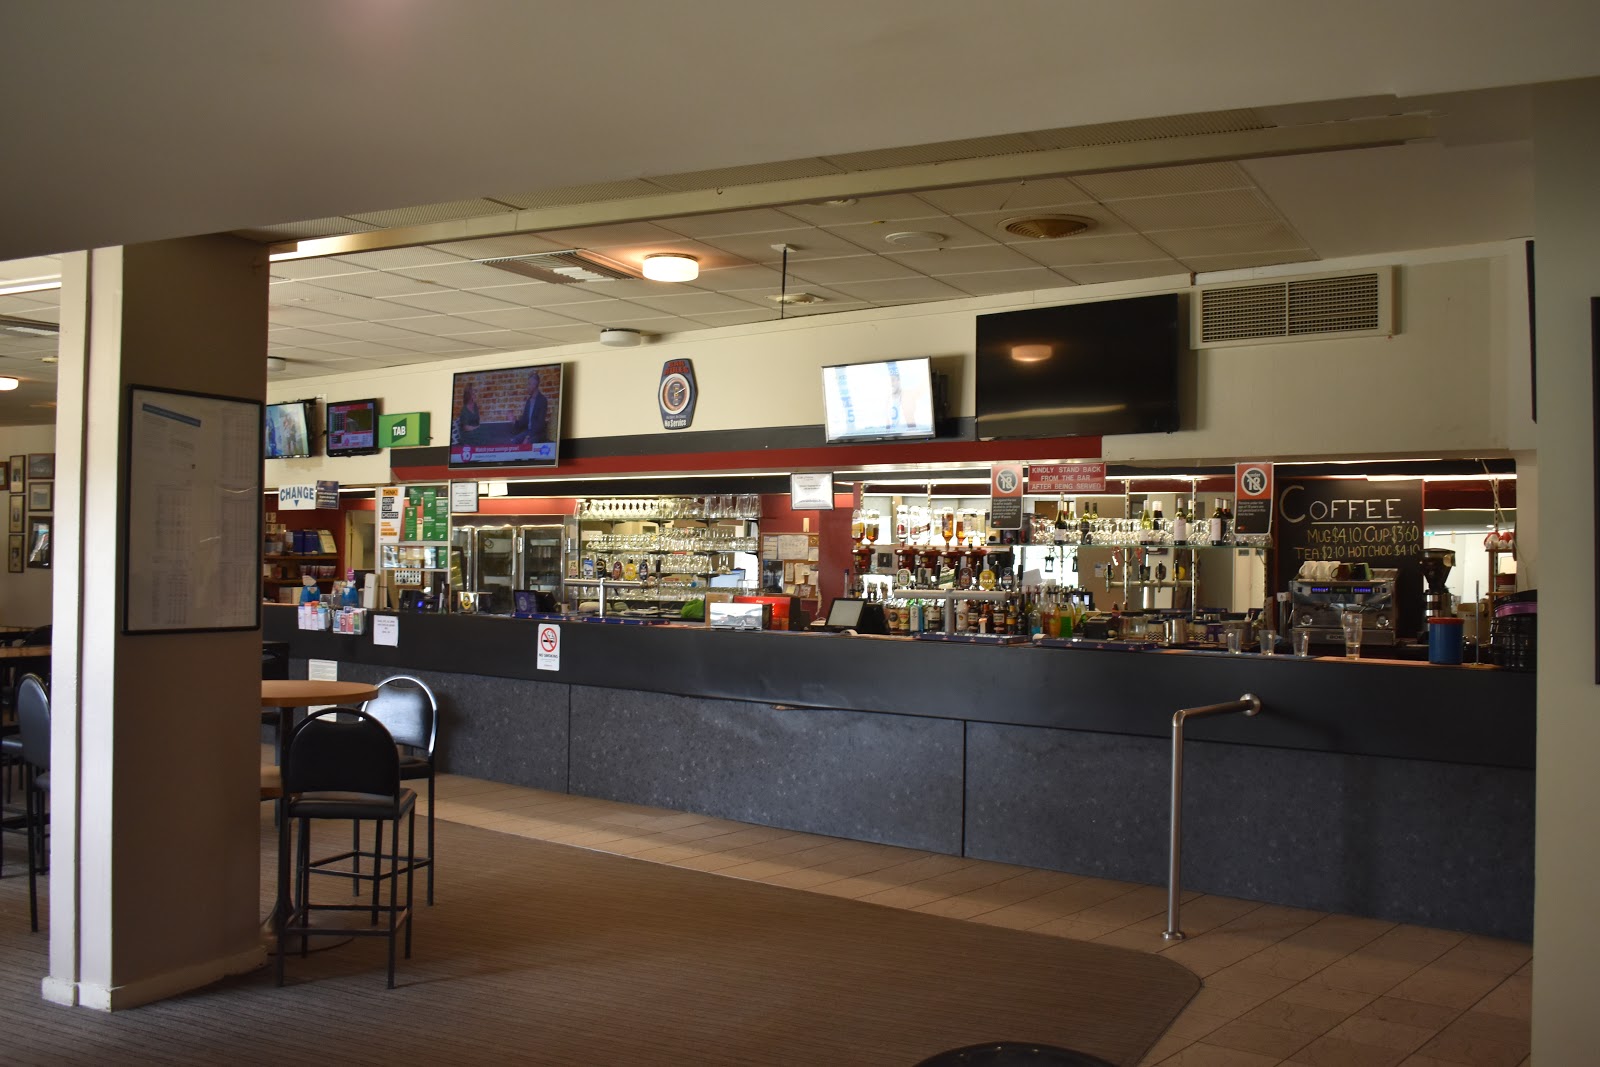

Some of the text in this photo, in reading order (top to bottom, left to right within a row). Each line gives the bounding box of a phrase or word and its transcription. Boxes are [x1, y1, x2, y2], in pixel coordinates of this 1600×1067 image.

[392, 425, 406, 436] TAB
[1247, 477, 1261, 491] 18
[280, 486, 314, 501] CHANGE
[1307, 528, 1331, 543] MUG
[1332, 526, 1362, 544] $4.10
[1293, 547, 1319, 560] TEA
[1348, 546, 1367, 558] HOT
[1368, 545, 1392, 557] CHOC
